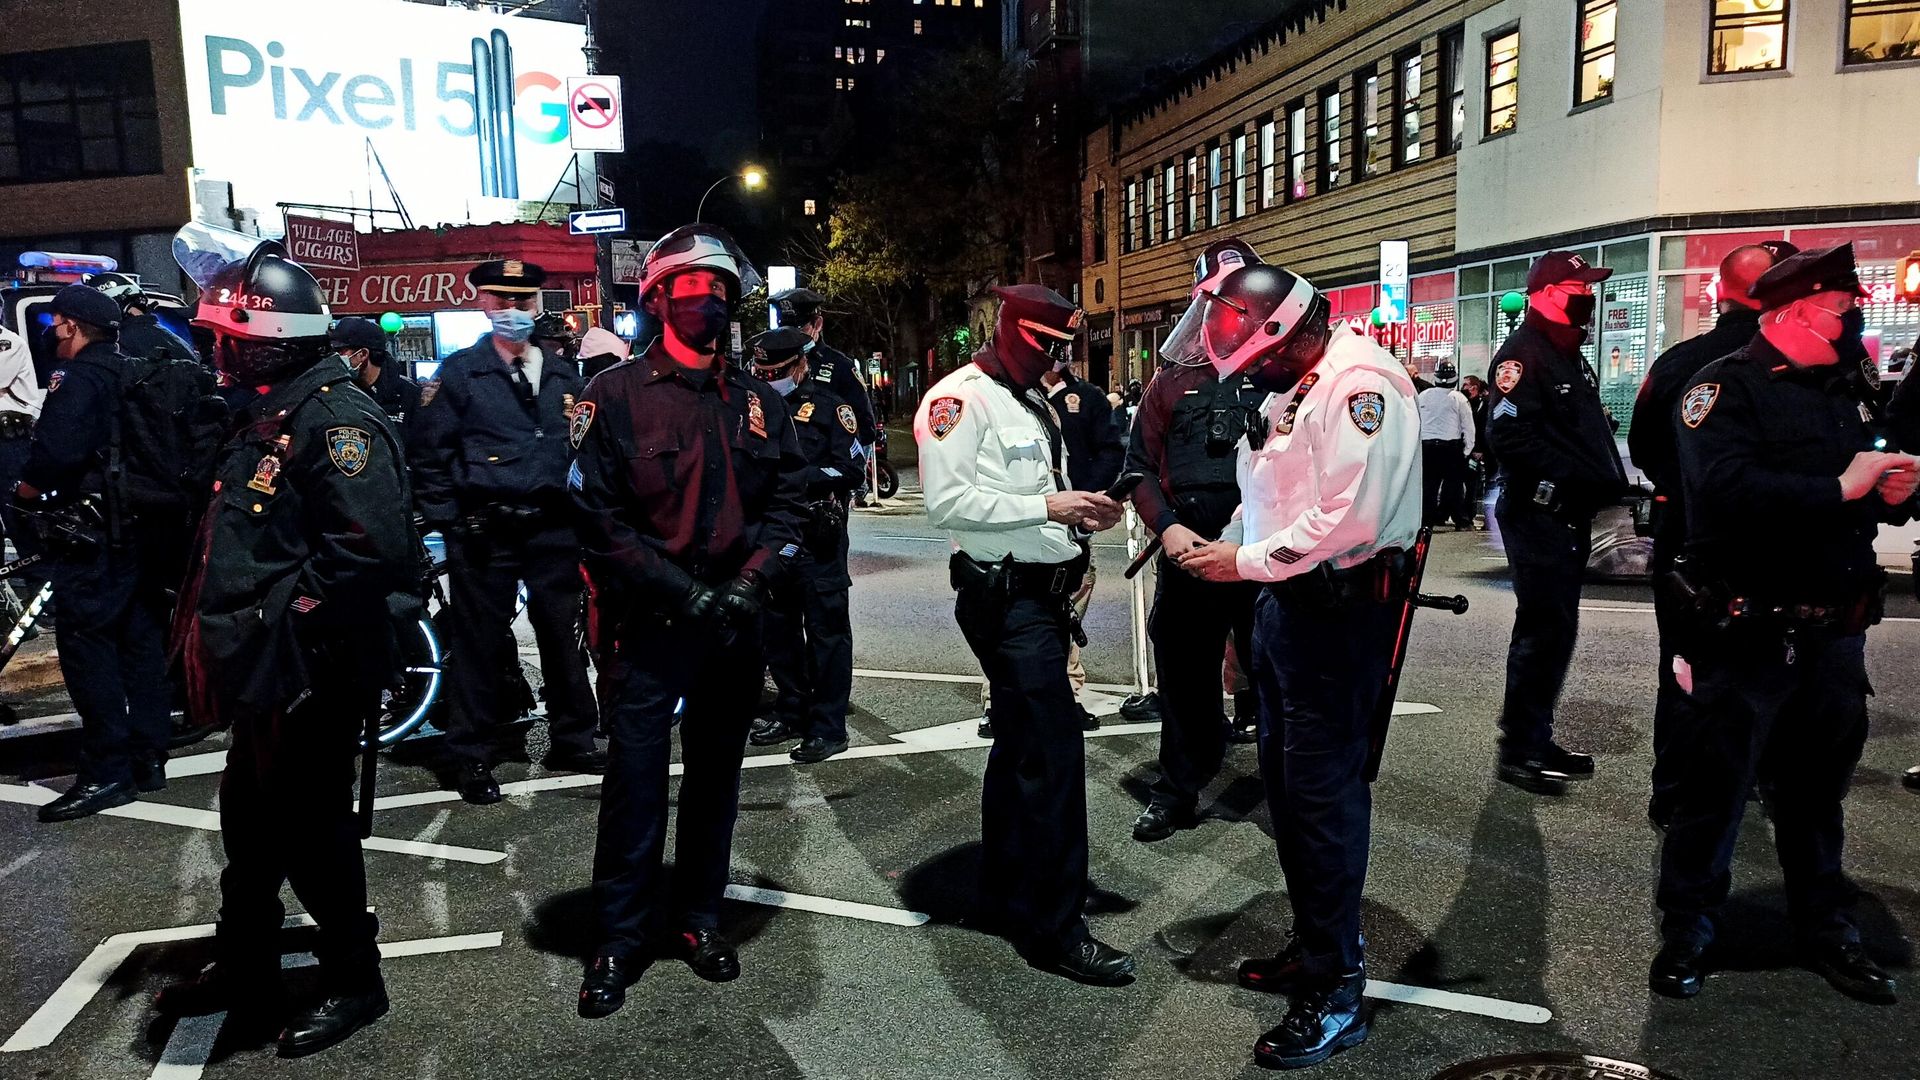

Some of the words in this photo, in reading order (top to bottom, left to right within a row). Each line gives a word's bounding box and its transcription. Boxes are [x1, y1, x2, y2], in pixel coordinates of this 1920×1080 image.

[205, 35, 416, 131] Pixel
[292, 223, 353, 245] VILLAGE
[295, 241, 353, 264] CIGARS
[361, 272, 478, 306] CIGARS
[1608, 308, 1628, 320] FREE
[1100, 327, 1111, 339] cat
[0, 553, 41, 576] OLICE
